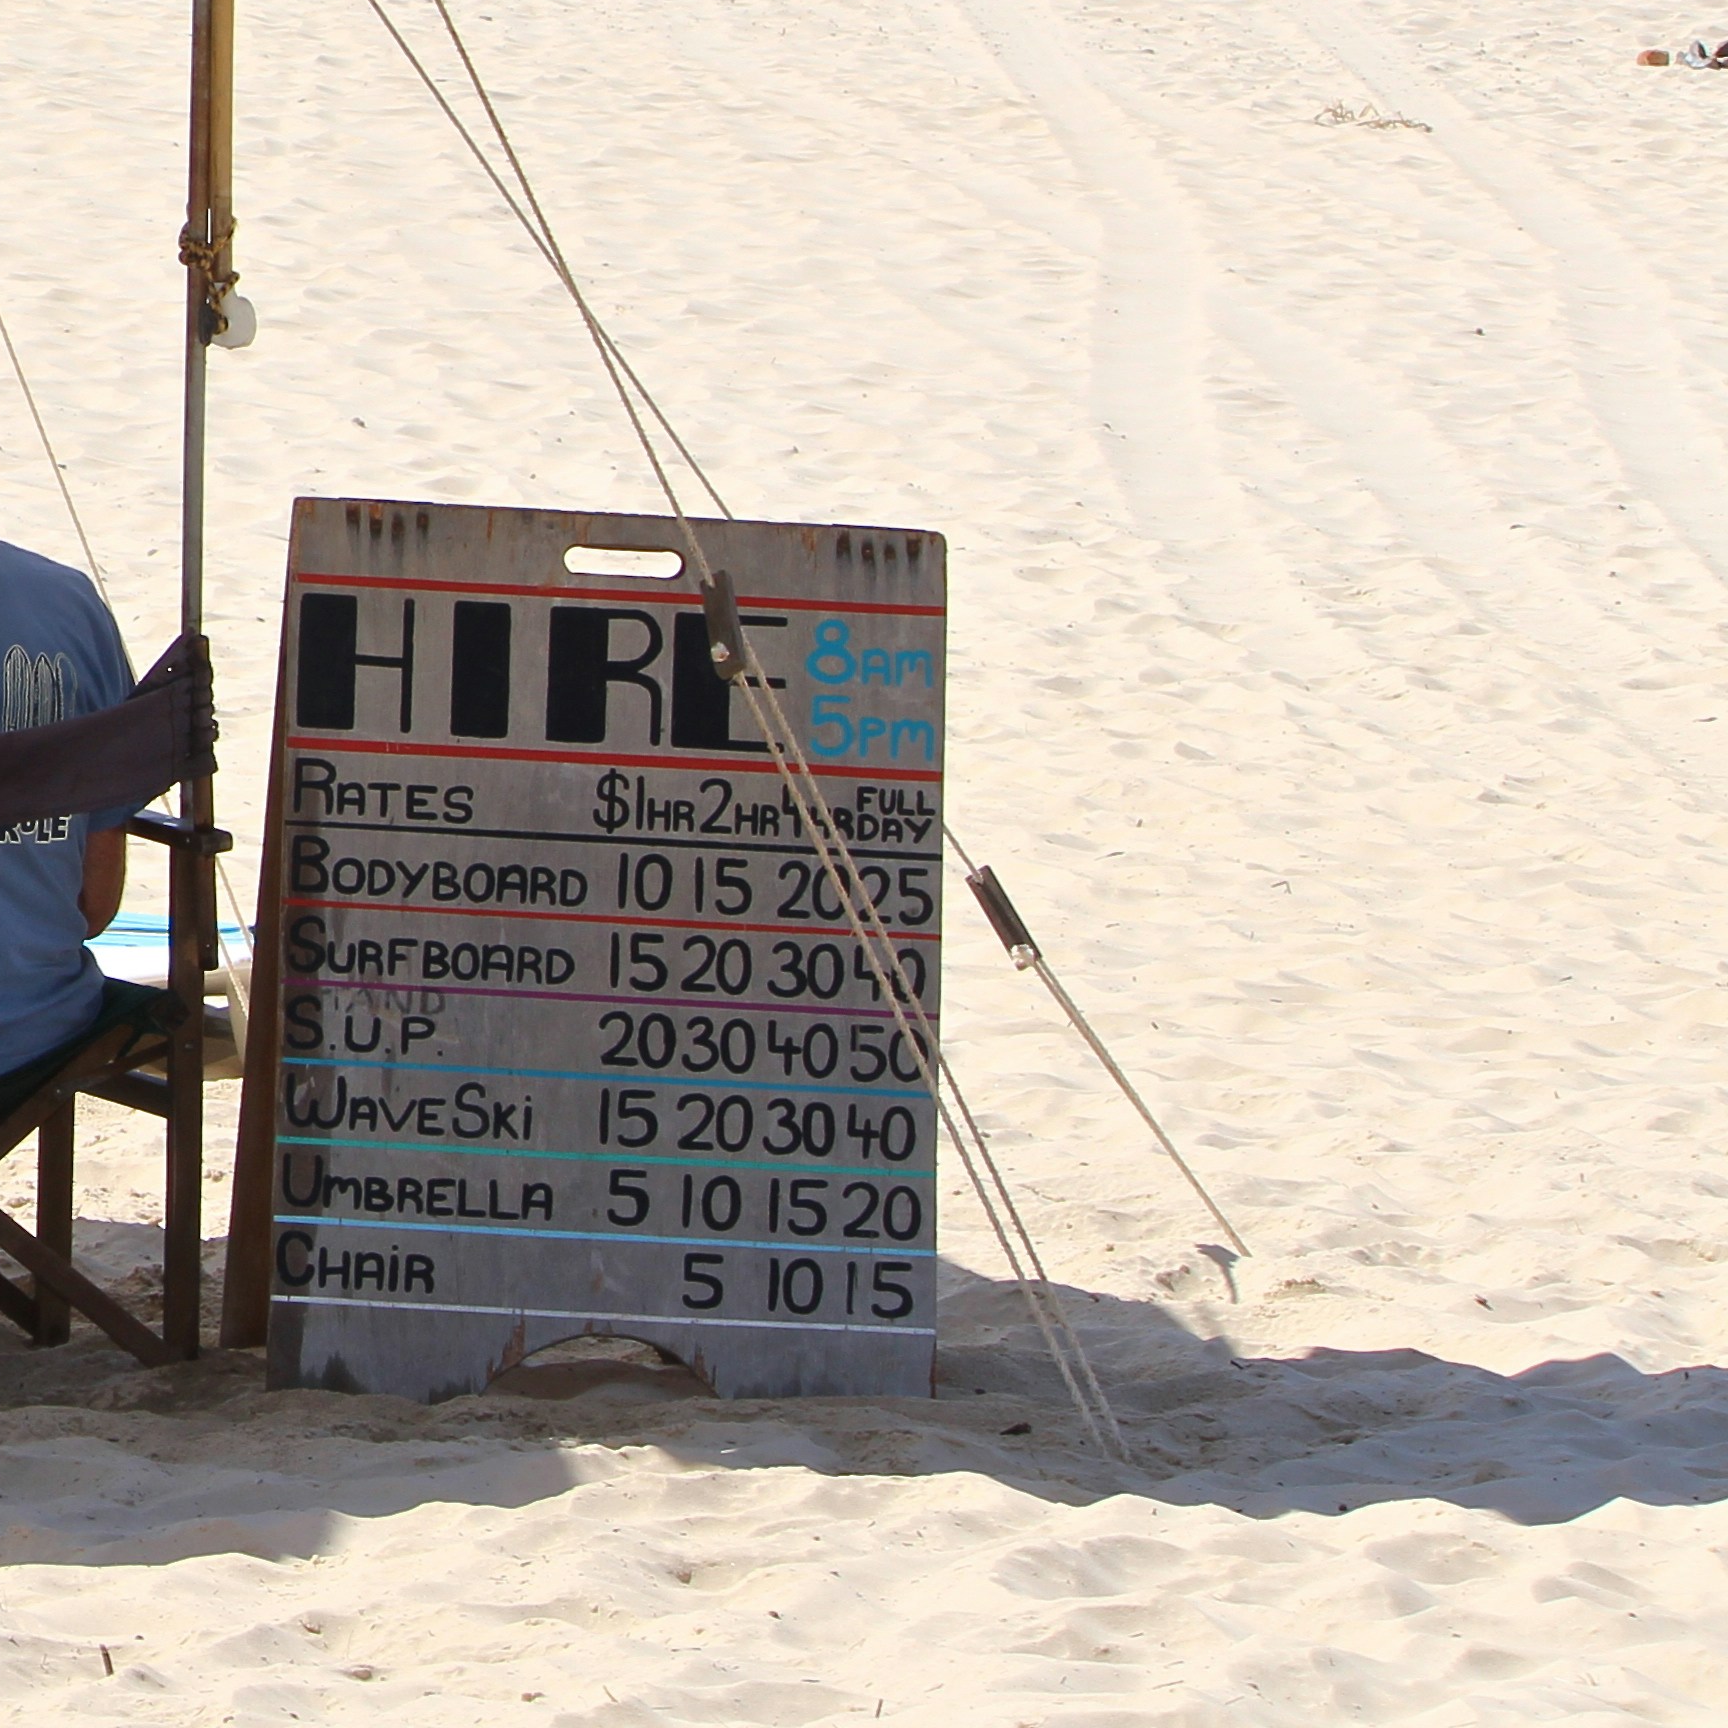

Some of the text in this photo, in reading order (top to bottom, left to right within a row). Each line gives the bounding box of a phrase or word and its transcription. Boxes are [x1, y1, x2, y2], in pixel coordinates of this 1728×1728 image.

[296, 592, 790, 754] HIRE
[293, 757, 475, 824] RATES
[698, 778, 780, 837] 2HR
[855, 785, 936, 817] FULL
[856, 817, 933, 845] DAY
[289, 834, 934, 926] BODYBOARD 10 15 20 25
[287, 915, 576, 986] SURFBOARD
[607, 933, 668, 993] 15
[680, 934, 752, 997] 20
[766, 939, 844, 1000] 30
[285, 994, 929, 1082] S.U.P. 20 30 40 50
[599, 1086, 659, 1148] 15
[675, 1094, 753, 1153] 20
[763, 1098, 835, 1158] 30
[846, 1103, 916, 1162] 40
[606, 1168, 650, 1227] 5
[682, 1172, 742, 1232] 10
[767, 1176, 829, 1238] 15
[842, 1181, 922, 1242] 20
[682, 1252, 725, 1310] 5
[766, 1255, 824, 1315] 10
[845, 1259, 915, 1320] 15
